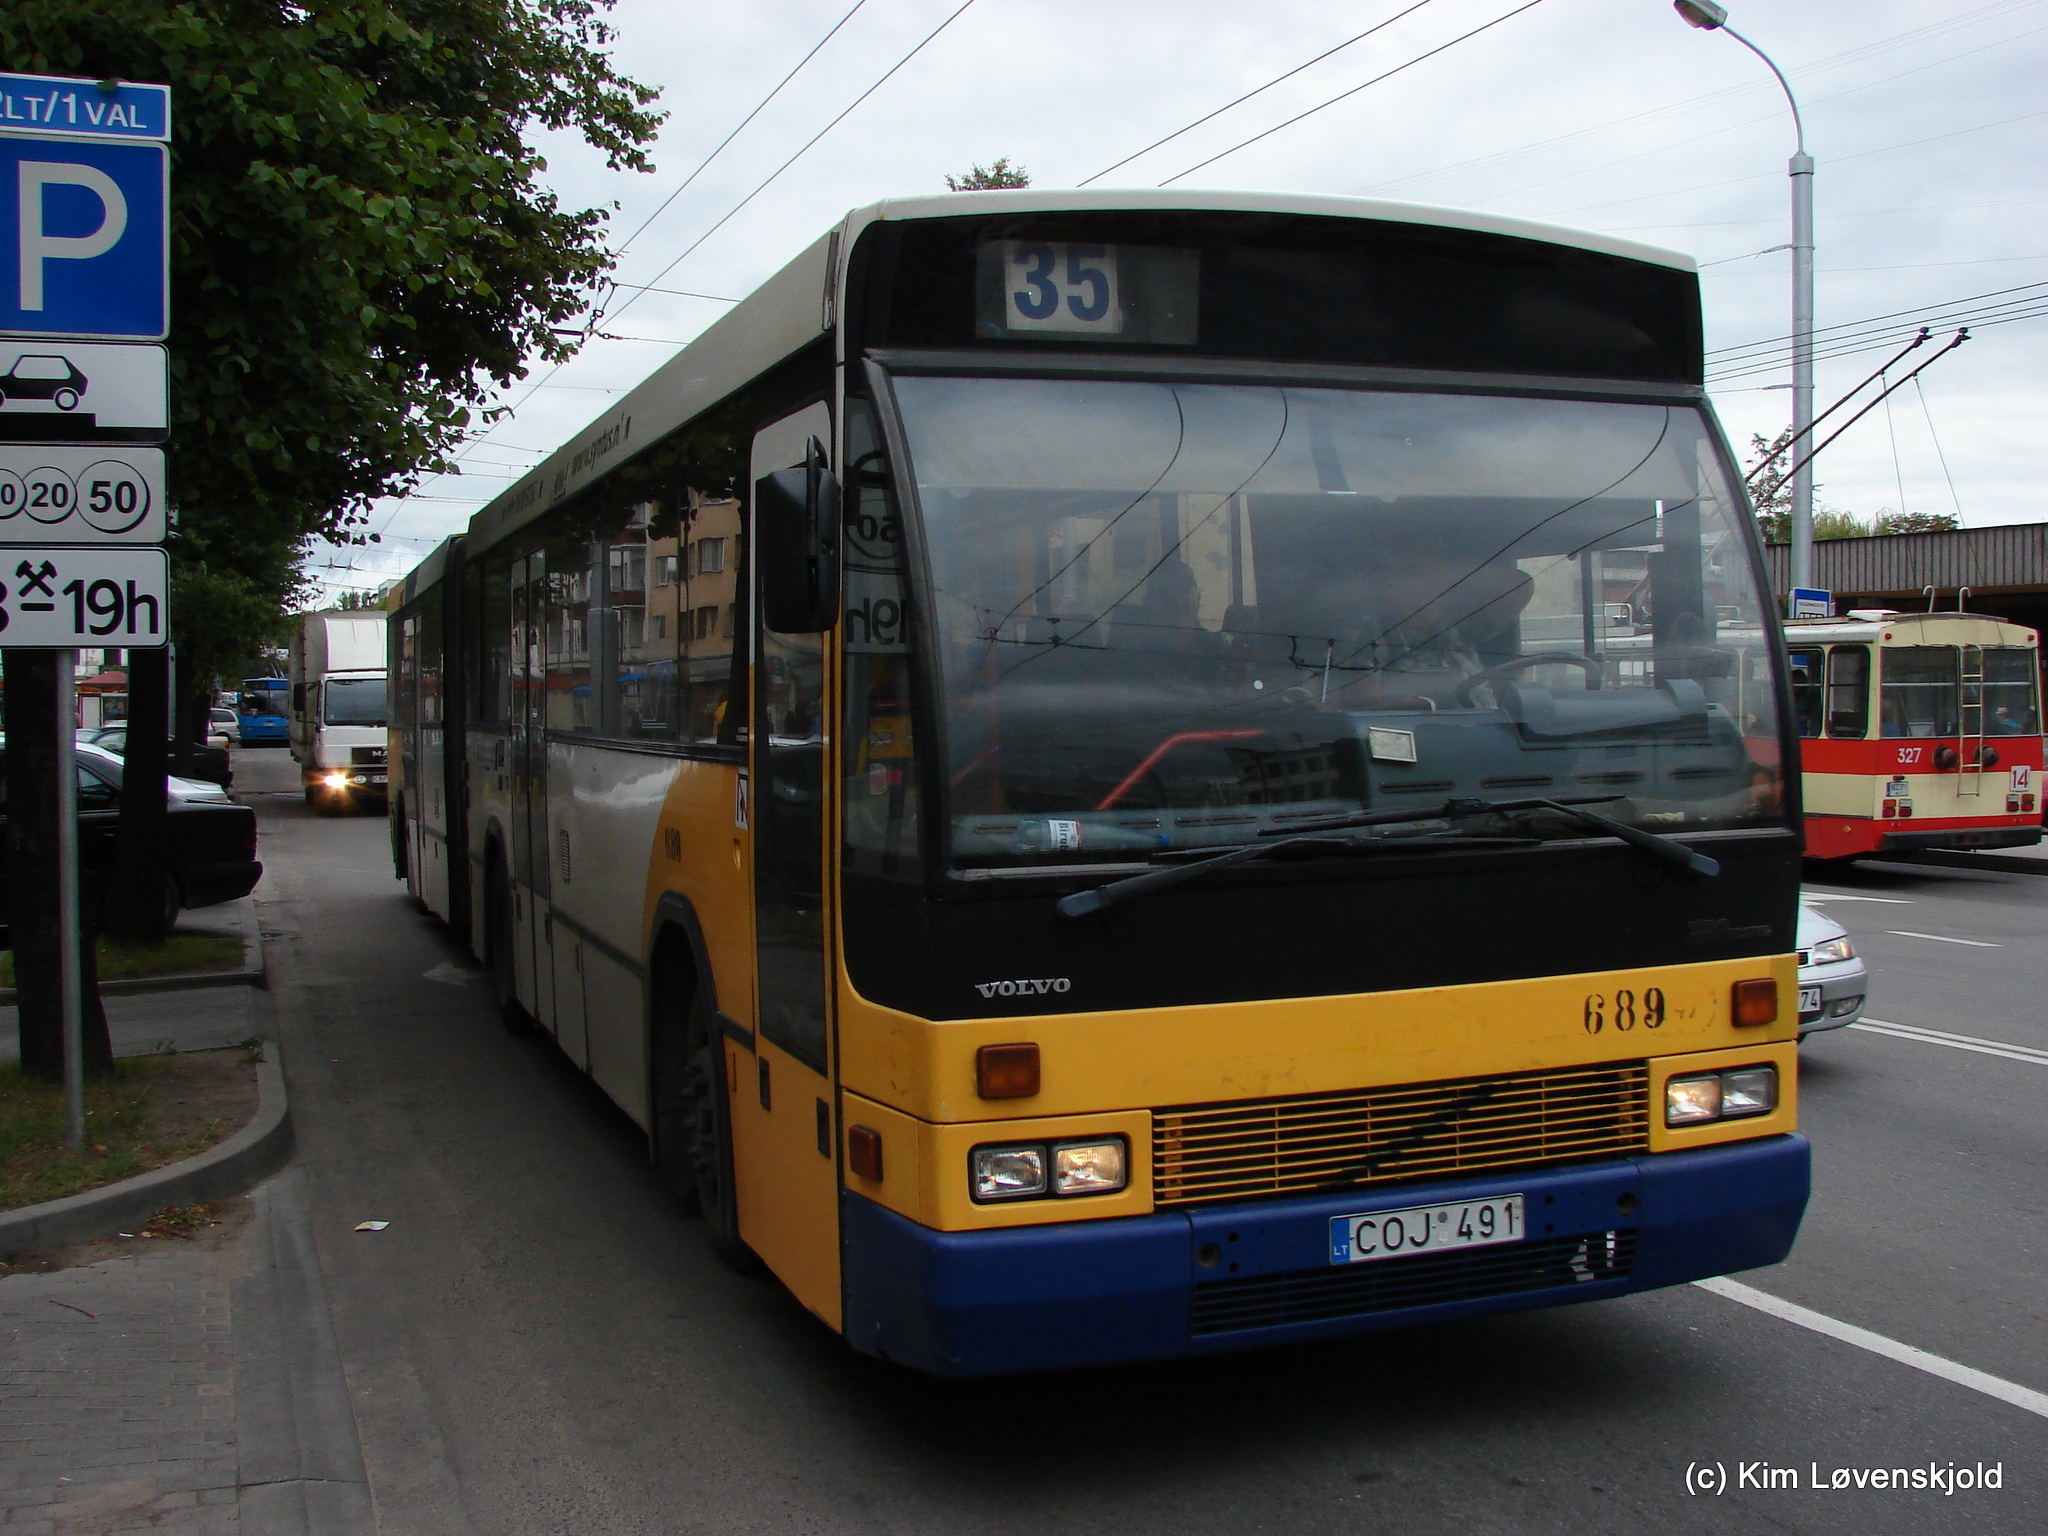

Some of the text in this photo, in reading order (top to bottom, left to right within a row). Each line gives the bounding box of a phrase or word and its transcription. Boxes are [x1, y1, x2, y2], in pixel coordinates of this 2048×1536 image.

[18, 160, 128, 311] P
[1013, 244, 1110, 321] 35
[31, 482, 69, 508] 20
[89, 480, 138, 514] 50
[1897, 748, 1922, 763] 327
[2012, 769, 2029, 788] 14
[974, 978, 1071, 998] VOLVO
[1801, 990, 1818, 1010] 74
[1583, 987, 1665, 1034] 689
[1333, 1201, 1514, 1256] LT COJ 491
